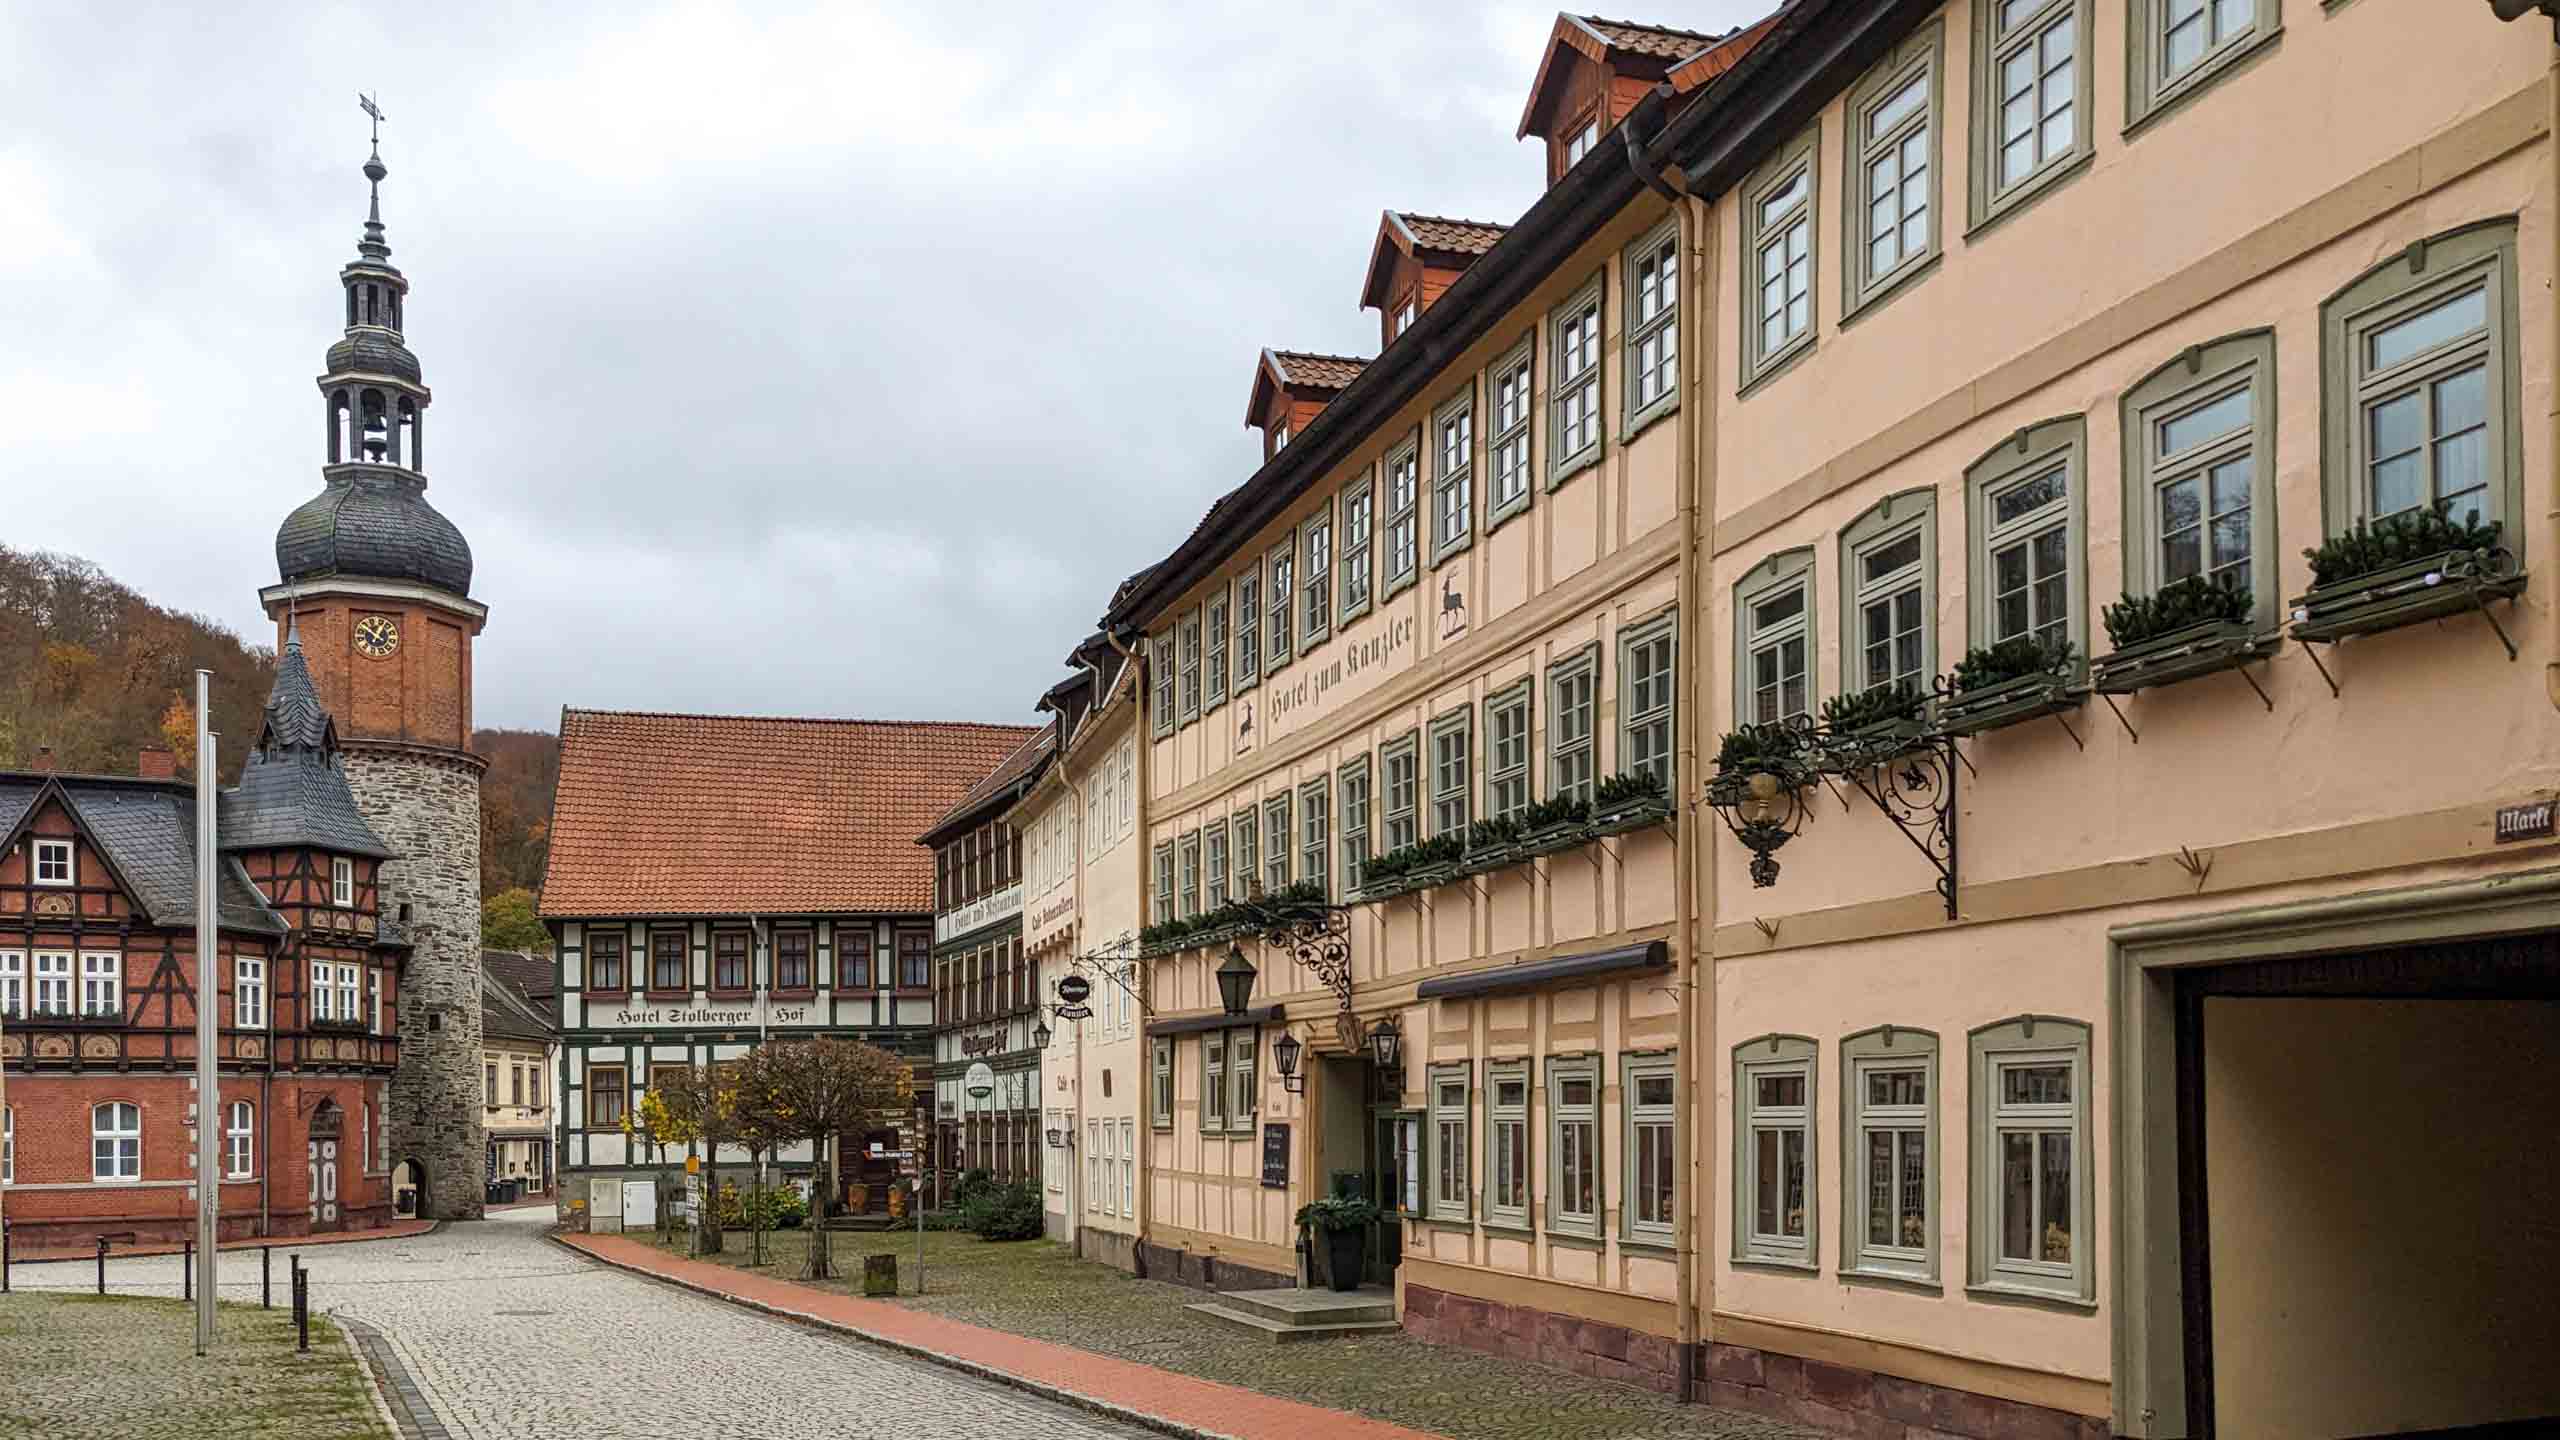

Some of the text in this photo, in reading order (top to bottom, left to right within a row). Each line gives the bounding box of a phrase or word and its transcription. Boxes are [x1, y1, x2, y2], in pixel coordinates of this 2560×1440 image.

[1271, 615, 1413, 723] Hotel zum Kanzler
[2500, 807, 2550, 833] Markt
[616, 1008, 805, 1027] Hotel Stolberger Hof
